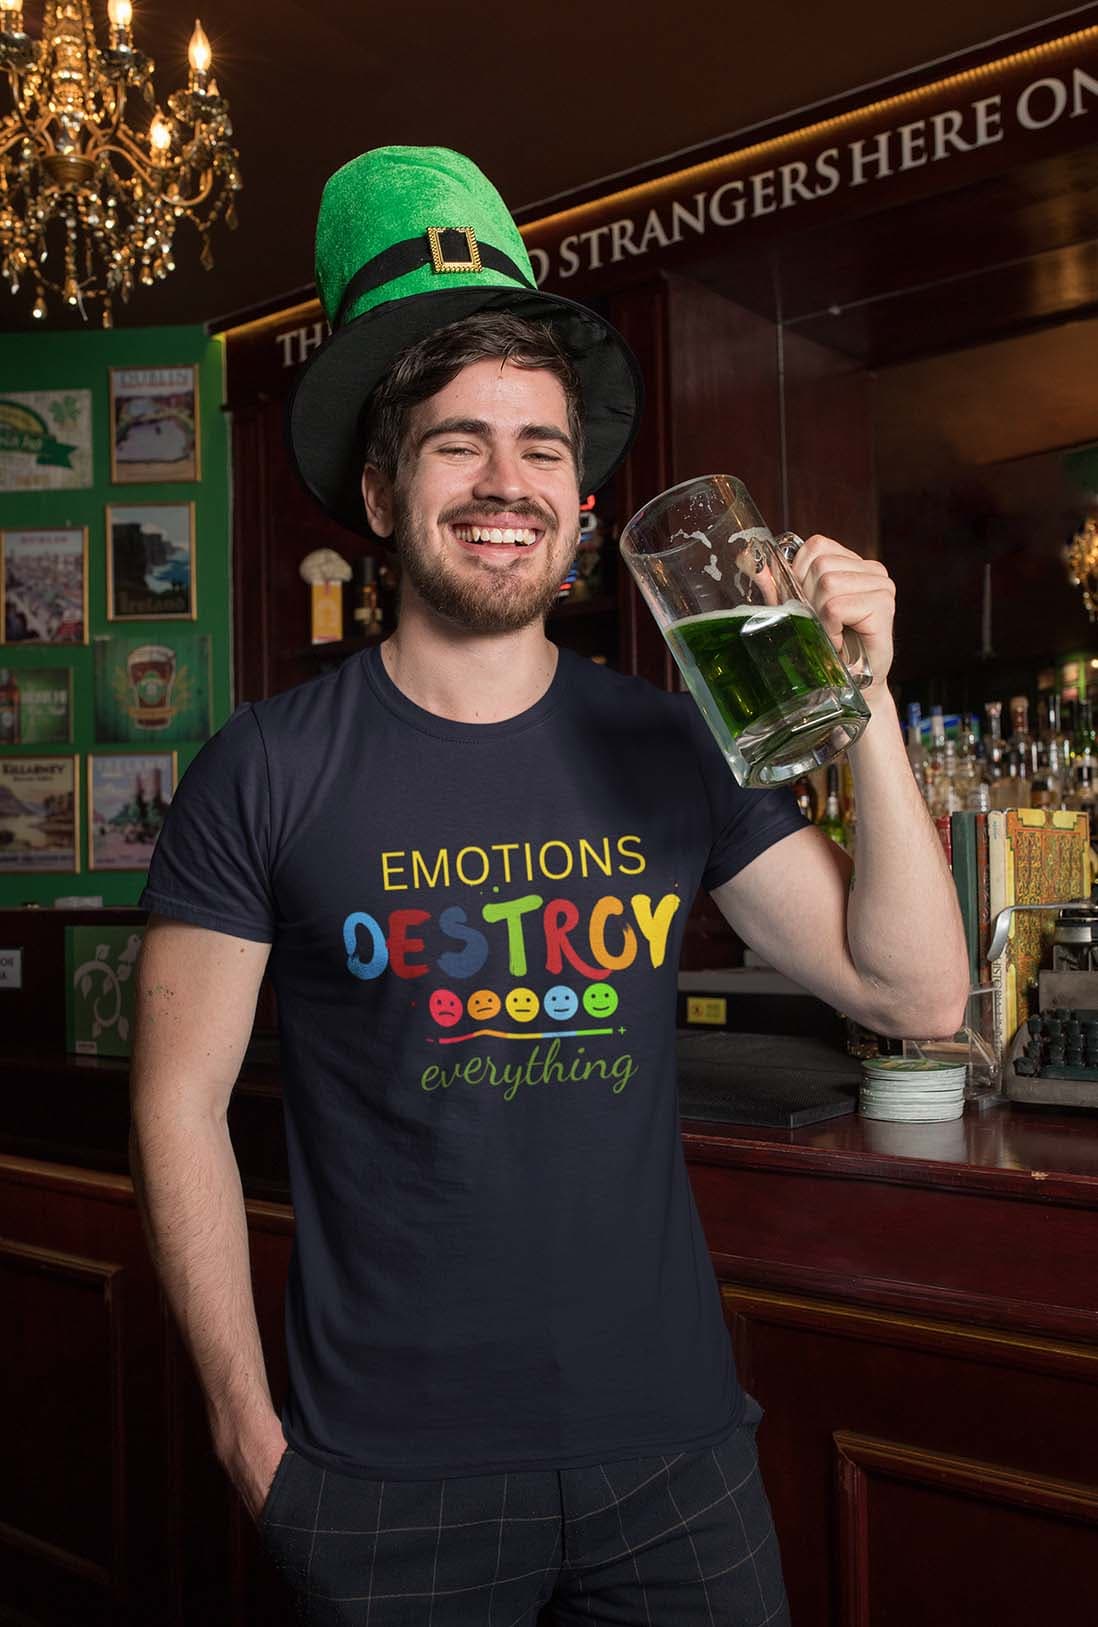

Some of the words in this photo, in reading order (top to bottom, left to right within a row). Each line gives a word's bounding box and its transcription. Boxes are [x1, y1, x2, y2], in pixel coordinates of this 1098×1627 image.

[559, 149, 839, 278] STRANGERS
[848, 95, 1004, 187] HERE
[2, 763, 66, 775] KILLARNEY
[381, 835, 647, 892] EMOTIONS
[343, 893, 681, 981] DESTROY
[421, 1037, 639, 1101] everything
